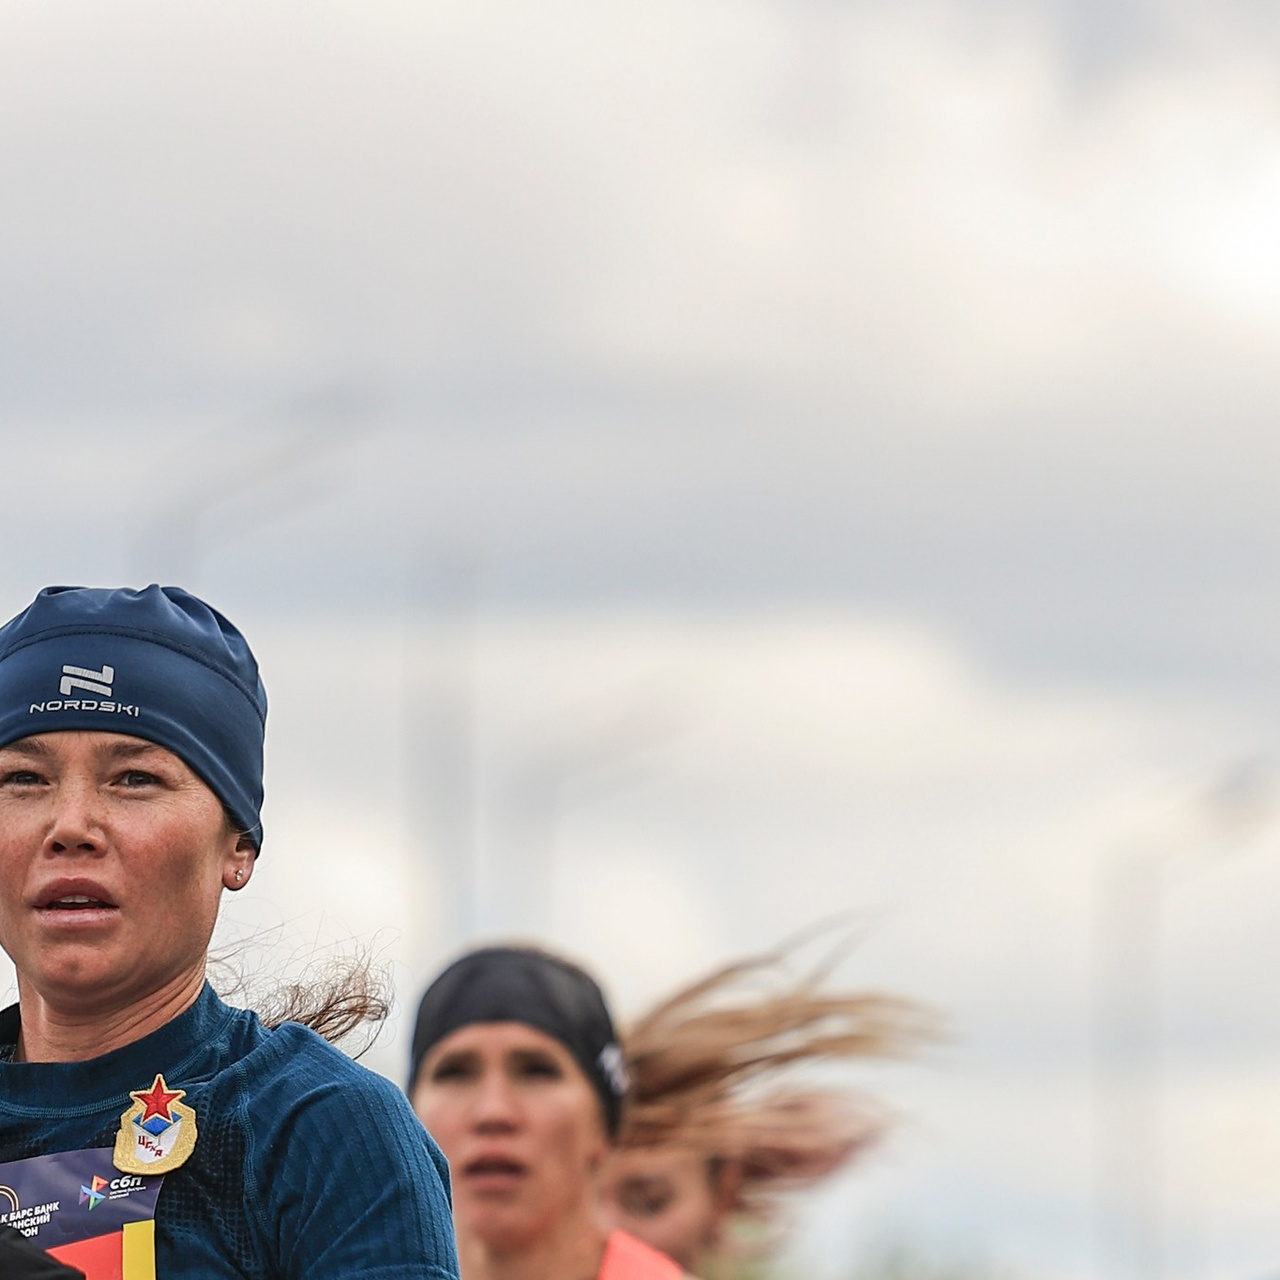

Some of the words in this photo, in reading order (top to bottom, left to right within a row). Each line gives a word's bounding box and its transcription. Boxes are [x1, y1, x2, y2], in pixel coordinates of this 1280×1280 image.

[29, 699, 141, 718] NORDSKI
[9, 1207, 34, 1221] БАРС
[34, 1201, 60, 1215] БАНК
[7, 1212, 51, 1230] АНСКИЙ
